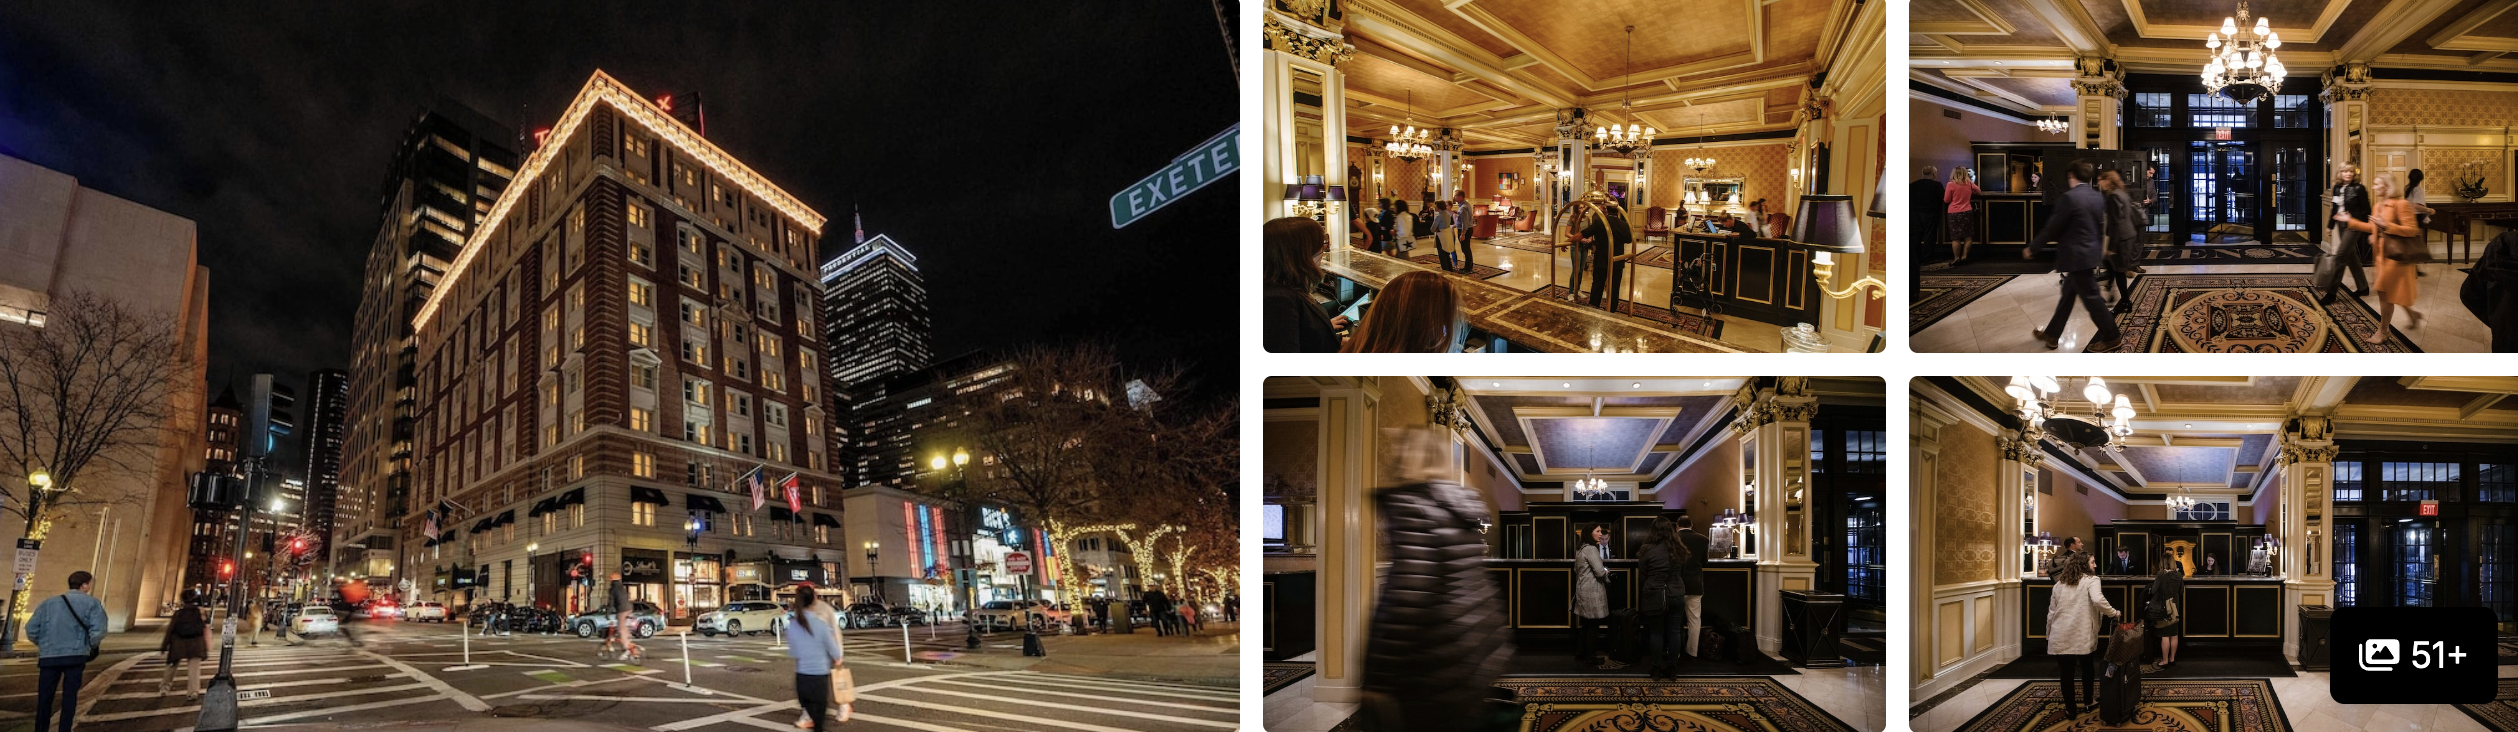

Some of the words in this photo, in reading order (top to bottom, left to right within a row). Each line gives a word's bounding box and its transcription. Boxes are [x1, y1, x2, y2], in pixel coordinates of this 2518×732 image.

[823, 245, 872, 273] PRUDENTIAL
[2422, 504, 2436, 515] EXIT
[736, 569, 757, 577] LENOX
